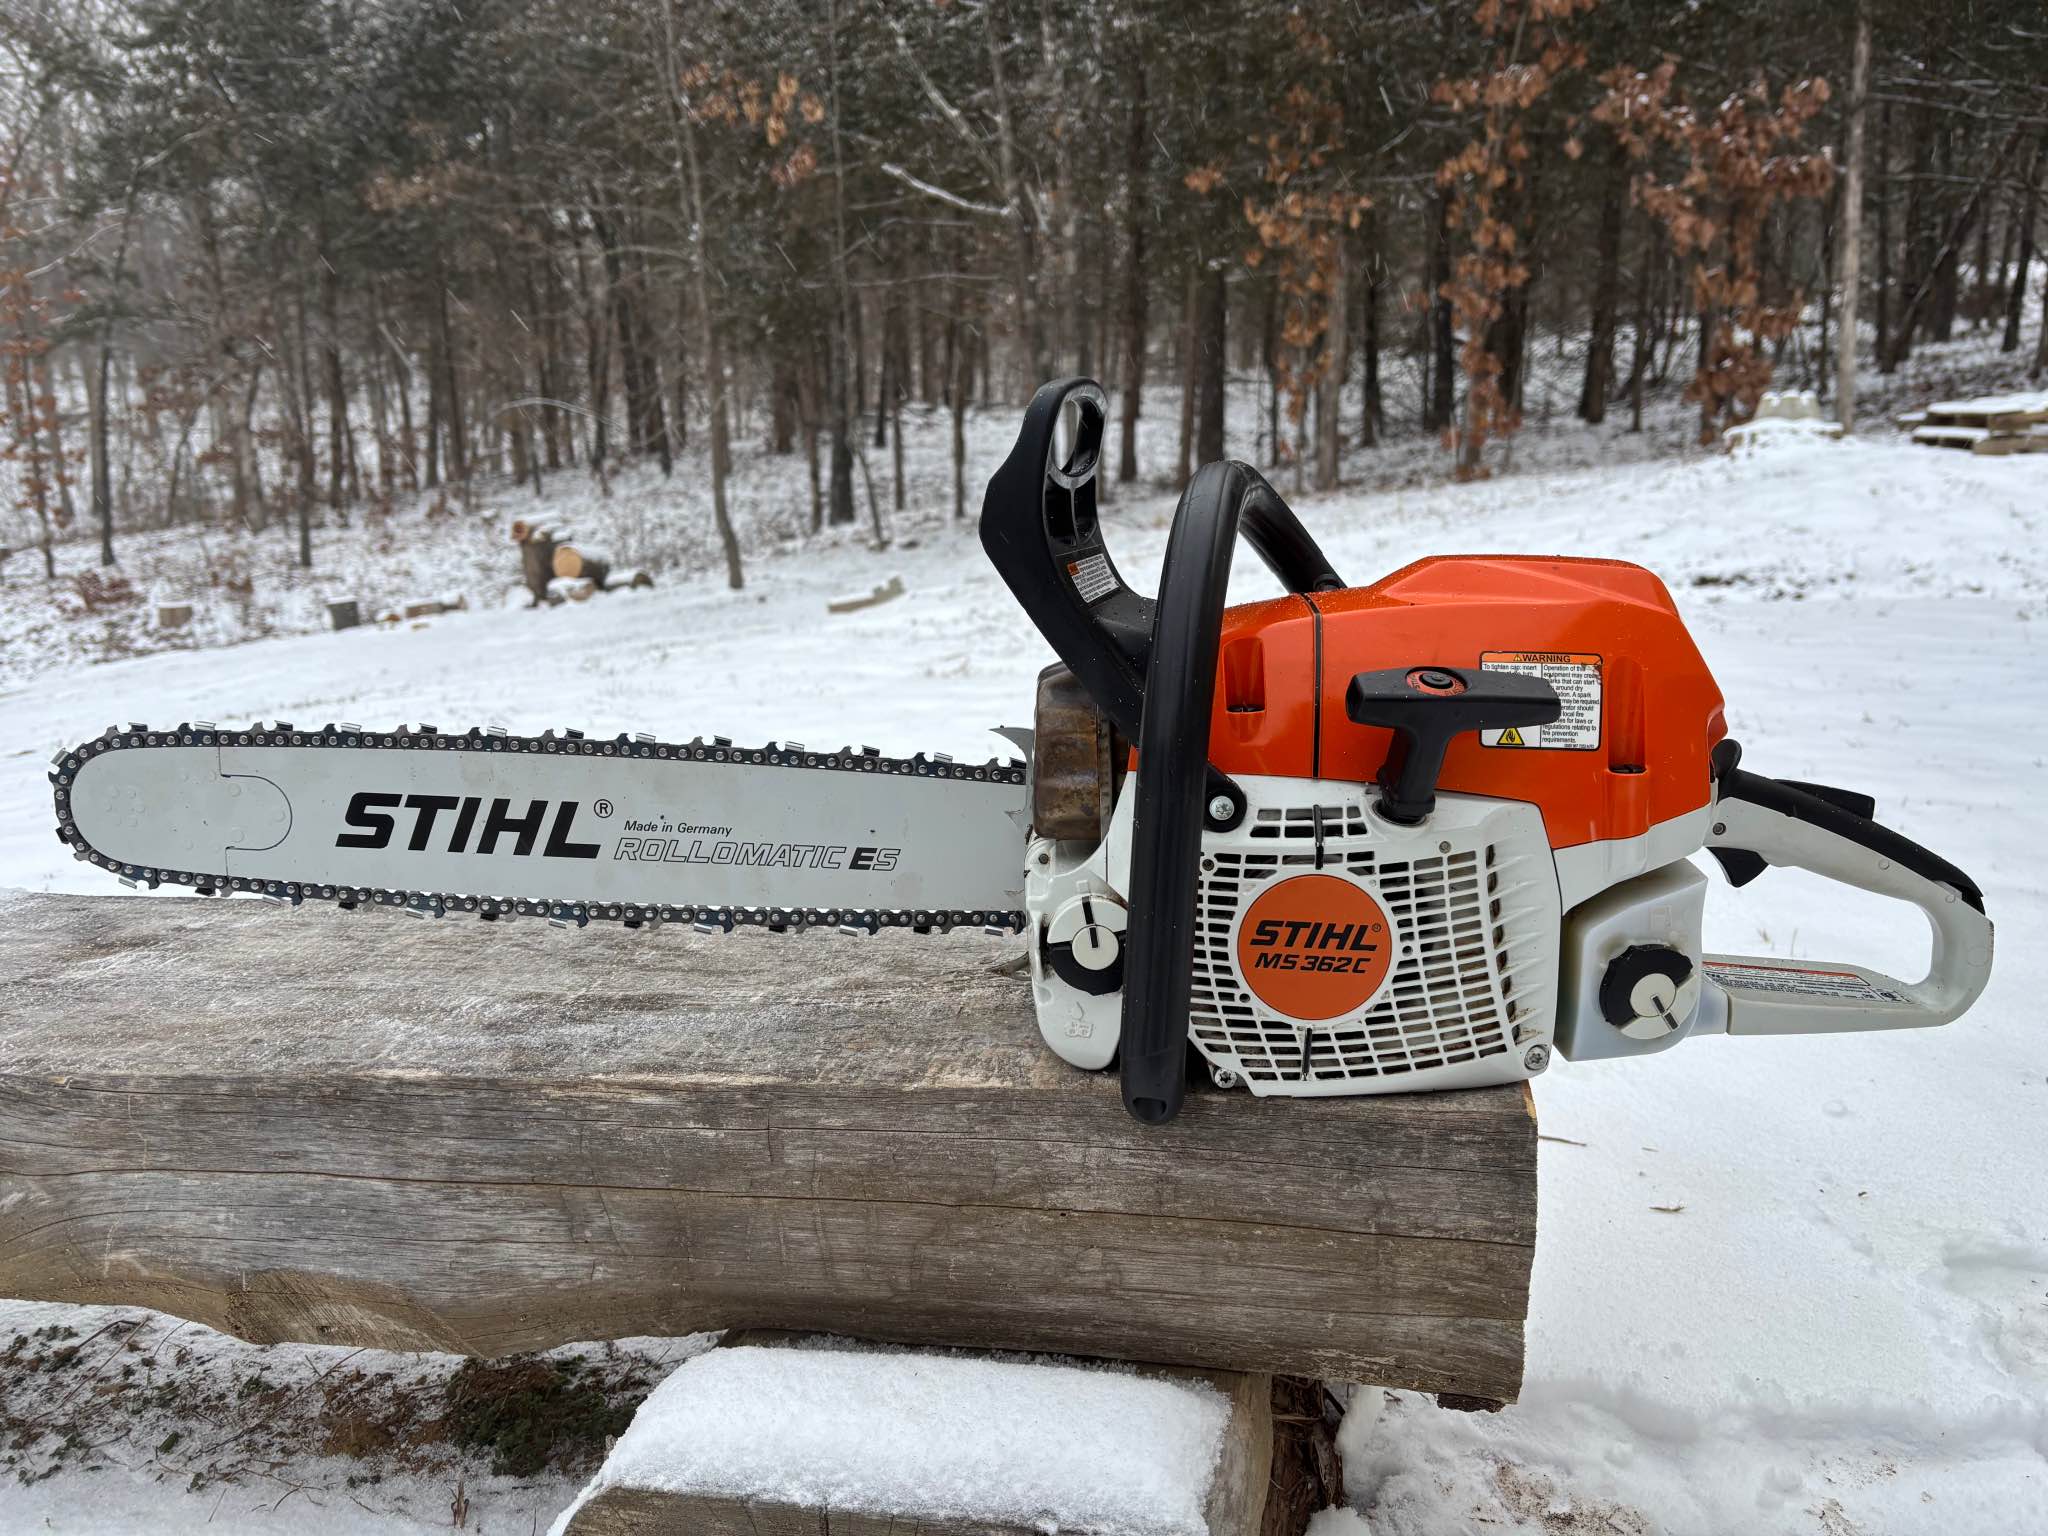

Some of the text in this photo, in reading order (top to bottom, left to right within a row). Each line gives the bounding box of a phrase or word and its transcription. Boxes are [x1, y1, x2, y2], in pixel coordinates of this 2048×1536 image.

[1522, 654, 1571, 663] WARNING
[335, 792, 601, 859] STIHL
[624, 820, 732, 837] Made in Germany
[614, 837, 902, 872] ROLLOMATIC ES
[1250, 920, 1378, 952] STIHL
